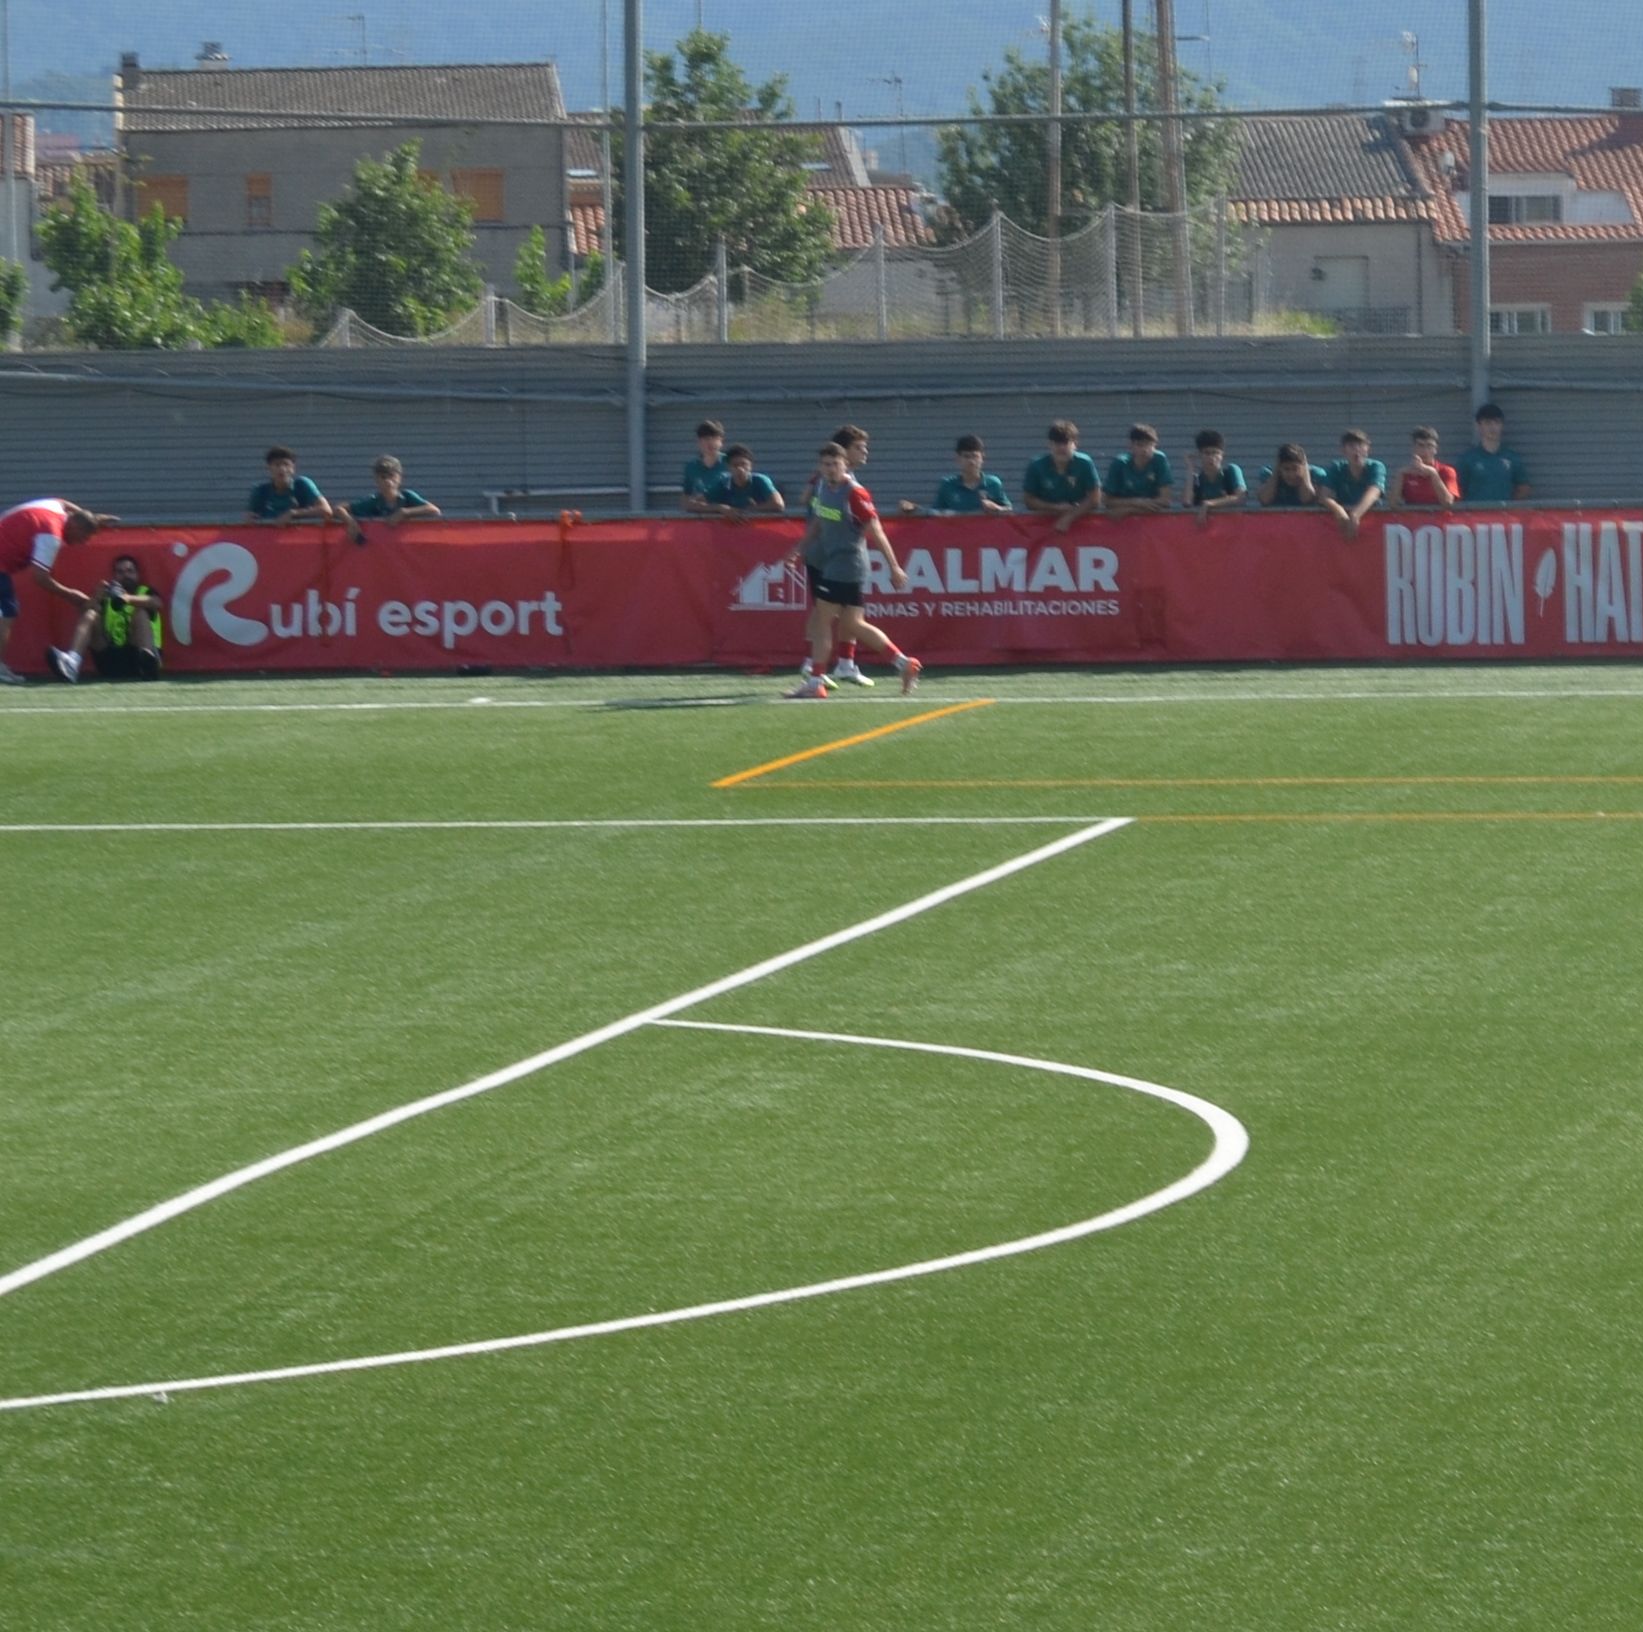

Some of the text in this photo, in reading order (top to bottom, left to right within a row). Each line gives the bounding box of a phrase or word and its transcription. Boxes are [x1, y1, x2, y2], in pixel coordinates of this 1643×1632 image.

[170, 542, 563, 649] Rubí esport
[860, 547, 1120, 594] RALMAR
[923, 602, 938, 617] Y
[941, 600, 1120, 617] REHABILITACIONES
[1385, 522, 1526, 646] ROBIN
